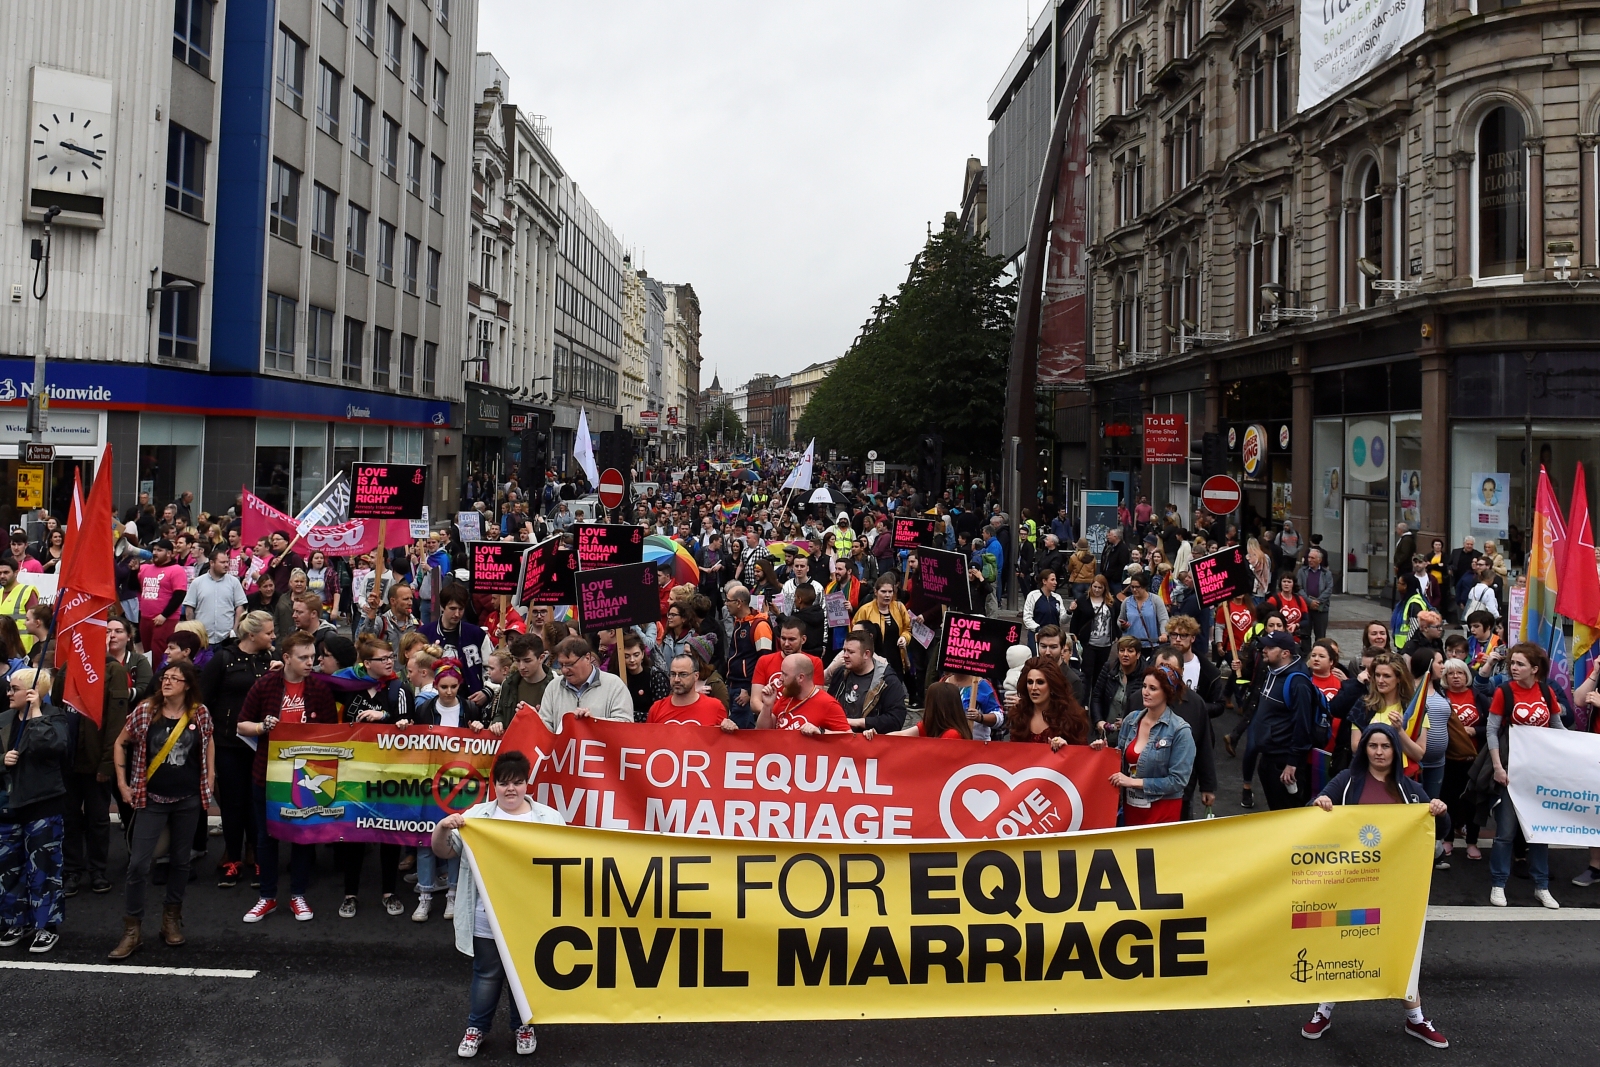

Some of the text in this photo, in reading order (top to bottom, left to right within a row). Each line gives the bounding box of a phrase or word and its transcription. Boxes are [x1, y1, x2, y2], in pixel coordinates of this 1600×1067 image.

[1313, 53, 1333, 72] DESIGN
[1340, 34, 1356, 55] BUILD
[1487, 149, 1521, 170] FIRST
[1484, 171, 1522, 192] FLOOR
[20, 381, 112, 401] Ntionwide
[351, 405, 371, 418] Nationwide
[512, 415, 527, 424] DW
[1146, 417, 1175, 426] To Let
[51, 426, 91, 434] Nationwide
[1243, 434, 1258, 451] BURGER
[1243, 443, 1258, 464] KING
[358, 467, 388, 477] LOVE
[357, 476, 378, 486] IS A
[356, 485, 398, 495] HUMAN
[355, 494, 390, 503] RIGHT
[579, 527, 607, 537] LOVE
[579, 536, 599, 545] IS A
[475, 545, 502, 555] LOVE
[529, 548, 543, 562] LOVE
[579, 544, 618, 554] HUMAN
[475, 554, 494, 563] IS A
[579, 552, 611, 561] RIGHT
[920, 556, 938, 568] LOVE
[475, 562, 513, 572] HUMAN
[526, 563, 545, 580] HUMAN
[921, 564, 935, 575] IS A
[1195, 558, 1217, 572] LOVE
[474, 571, 506, 580] RIGHT
[922, 573, 948, 585] HUMAN
[1197, 570, 1213, 579] IS A
[1199, 571, 1228, 587] HUMAN
[524, 574, 541, 590] RIGHT
[581, 579, 613, 593] LOVE
[923, 581, 944, 593] RIGHT
[1200, 580, 1224, 596] RIGHT
[582, 590, 605, 602] IS A
[583, 596, 628, 611] HUMAN
[584, 606, 620, 621] RIGHT
[586, 617, 632, 629] Amnesty International
[950, 617, 981, 631] LOVE
[949, 627, 971, 639] IS A
[947, 636, 991, 652] HUMAN
[946, 645, 982, 660] RIGHT
[945, 656, 995, 669] Amnesty International
[377, 733, 460, 754] WORKING
[619, 747, 894, 796] FOR EQUAL
[1535, 785, 1600, 802] Promotin
[531, 782, 914, 840] IVIL MARRIAGE
[1541, 800, 1590, 814] and/or
[982, 788, 1052, 840] OVE
[356, 817, 436, 834] HAZELWOOD
[1291, 850, 1382, 866] CONGRESS
[1306, 869, 1333, 877] Congress
[532, 847, 1184, 920] TIME FOR EQUAL
[1291, 901, 1338, 912] rainbow
[1340, 926, 1380, 939] project
[534, 916, 1209, 991] CIVIL MARRIAGE
[1315, 958, 1365, 970] Amnesty
[1315, 967, 1381, 981] International
